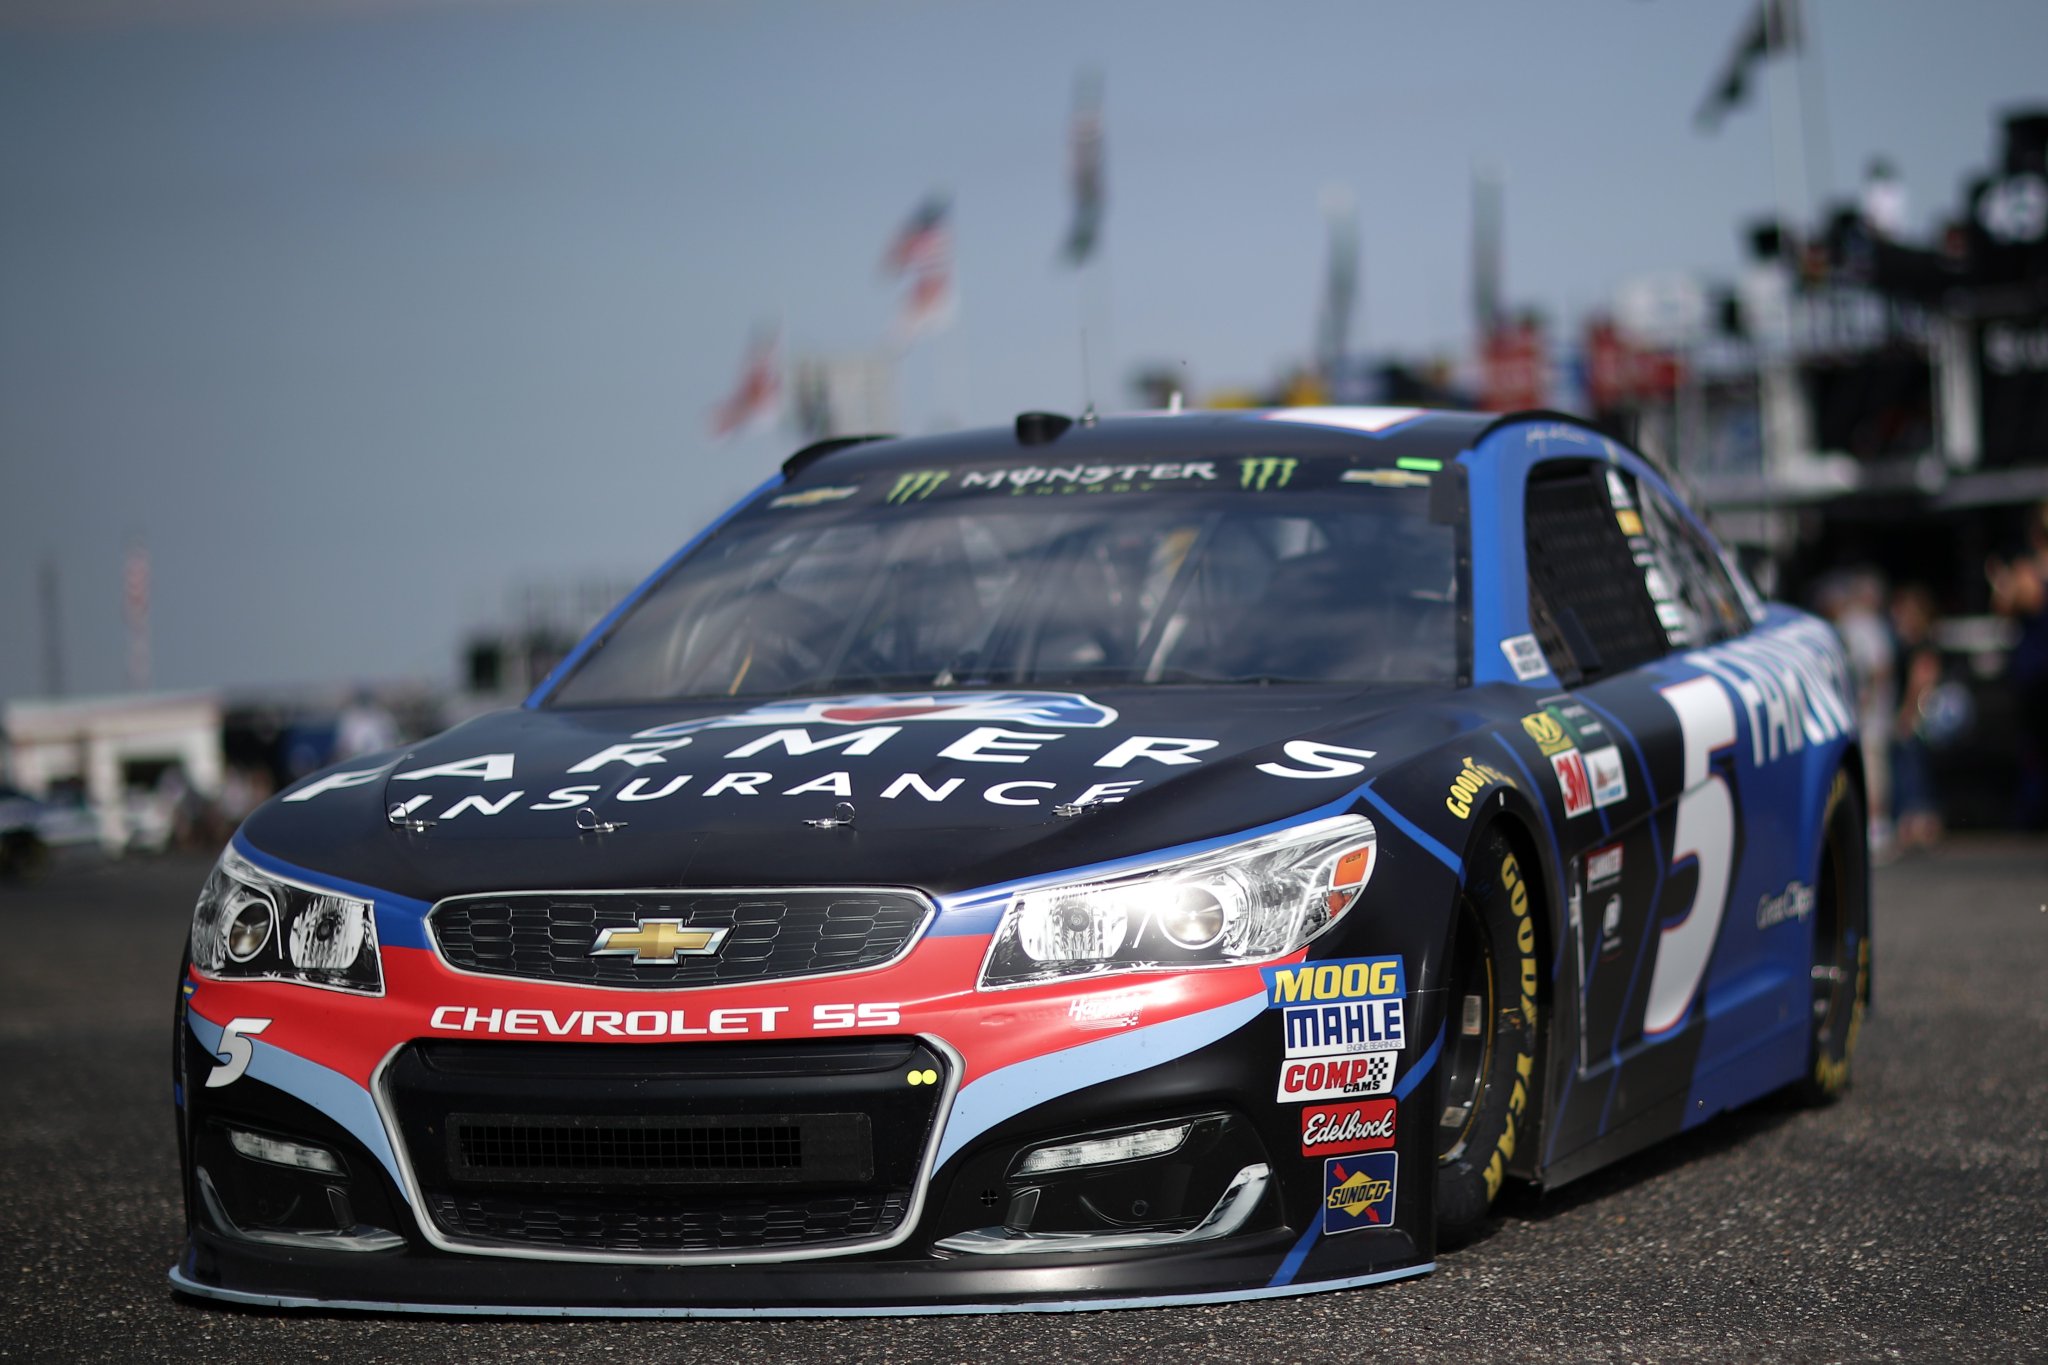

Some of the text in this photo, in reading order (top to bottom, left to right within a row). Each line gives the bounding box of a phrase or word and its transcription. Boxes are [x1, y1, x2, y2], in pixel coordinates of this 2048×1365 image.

[961, 462, 1218, 488] MONSTER
[282, 726, 1377, 802] FARMERS
[1556, 752, 1592, 812] 3M
[389, 771, 1144, 820] INSURANCE
[1643, 674, 1737, 1034] 5
[1274, 960, 1398, 1004] MOOG
[430, 1003, 900, 1036] CHEVROLET SS
[1286, 1002, 1401, 1048] MAHLE
[205, 1018, 272, 1087] 5
[1283, 1058, 1368, 1093] COMP
[1343, 1080, 1381, 1093] CAMS
[1302, 1108, 1394, 1146] Edelbrock
[1329, 1180, 1388, 1207] SUNOCO
